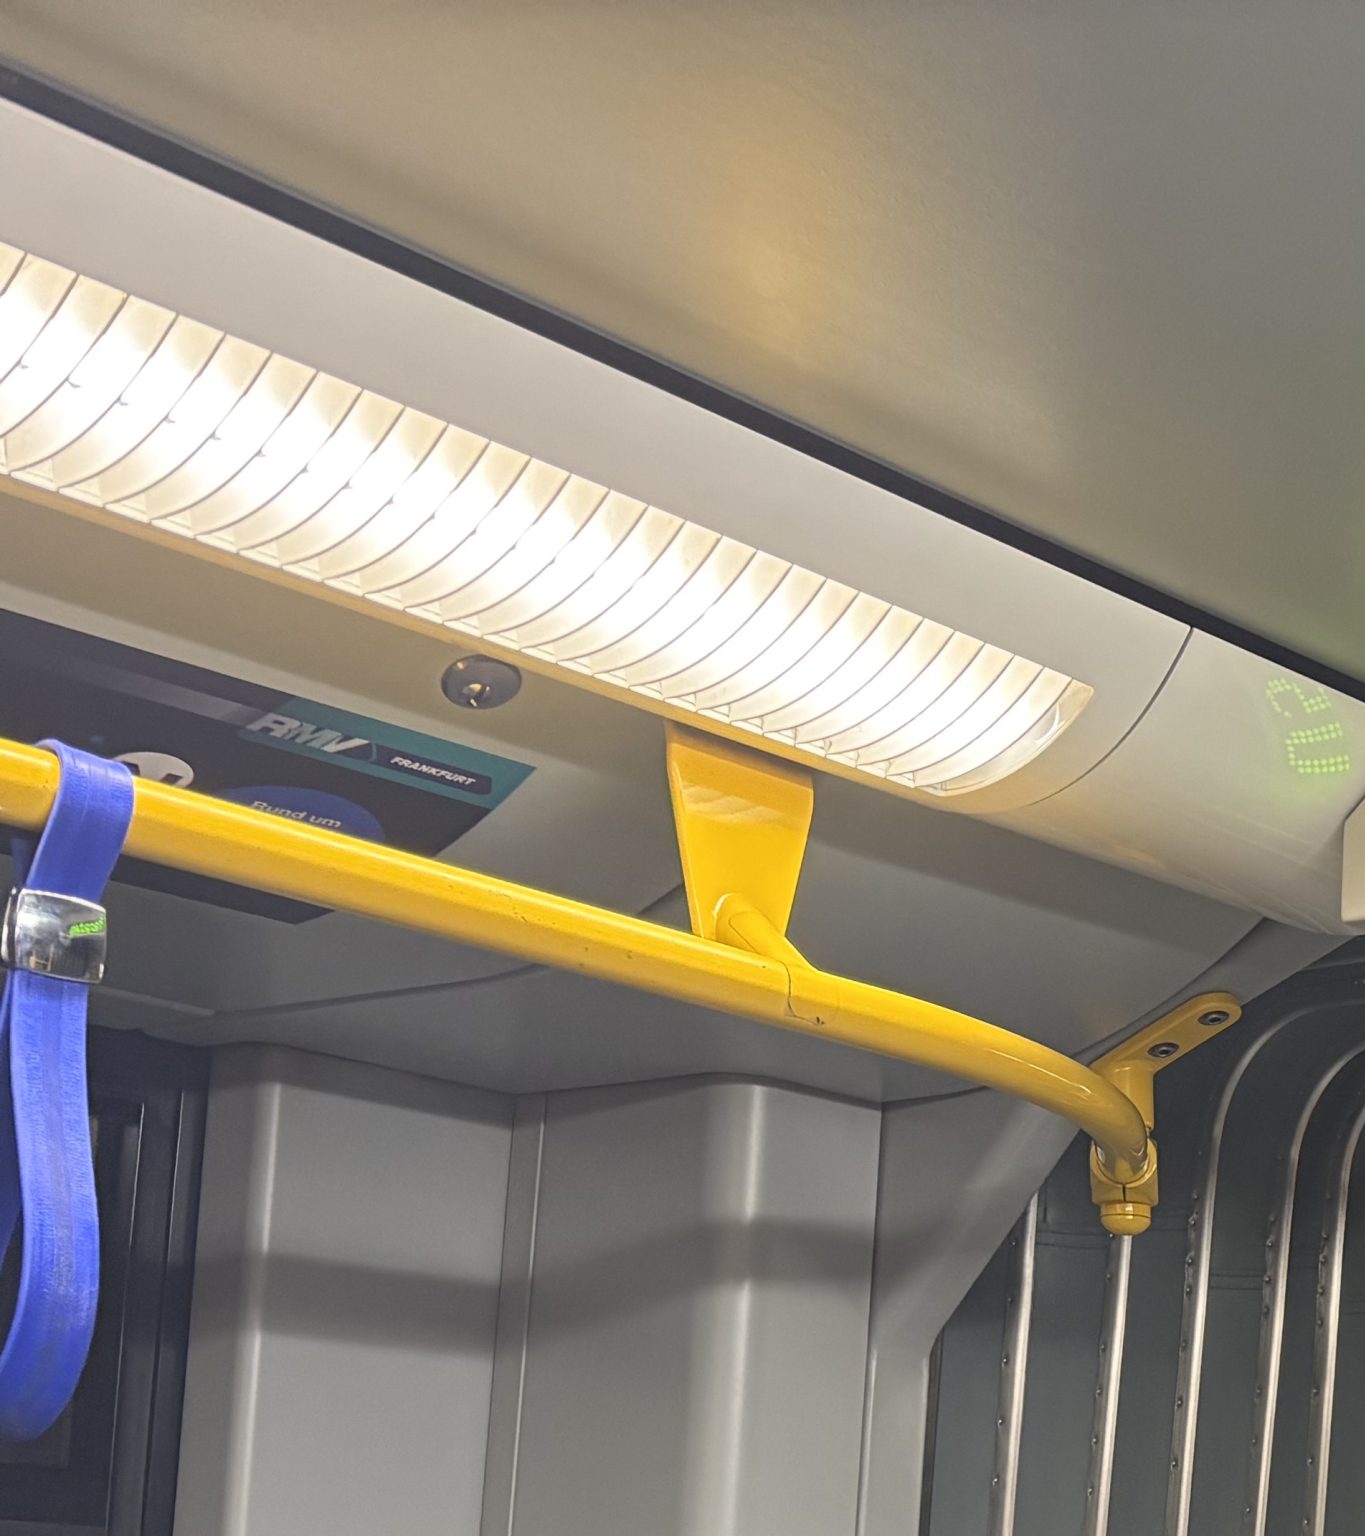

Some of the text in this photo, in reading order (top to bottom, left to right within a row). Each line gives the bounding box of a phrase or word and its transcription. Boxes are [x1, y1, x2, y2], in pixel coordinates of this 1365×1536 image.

[246, 712, 477, 786] RMV FRANKFURT
[250, 800, 342, 829] Rund um
